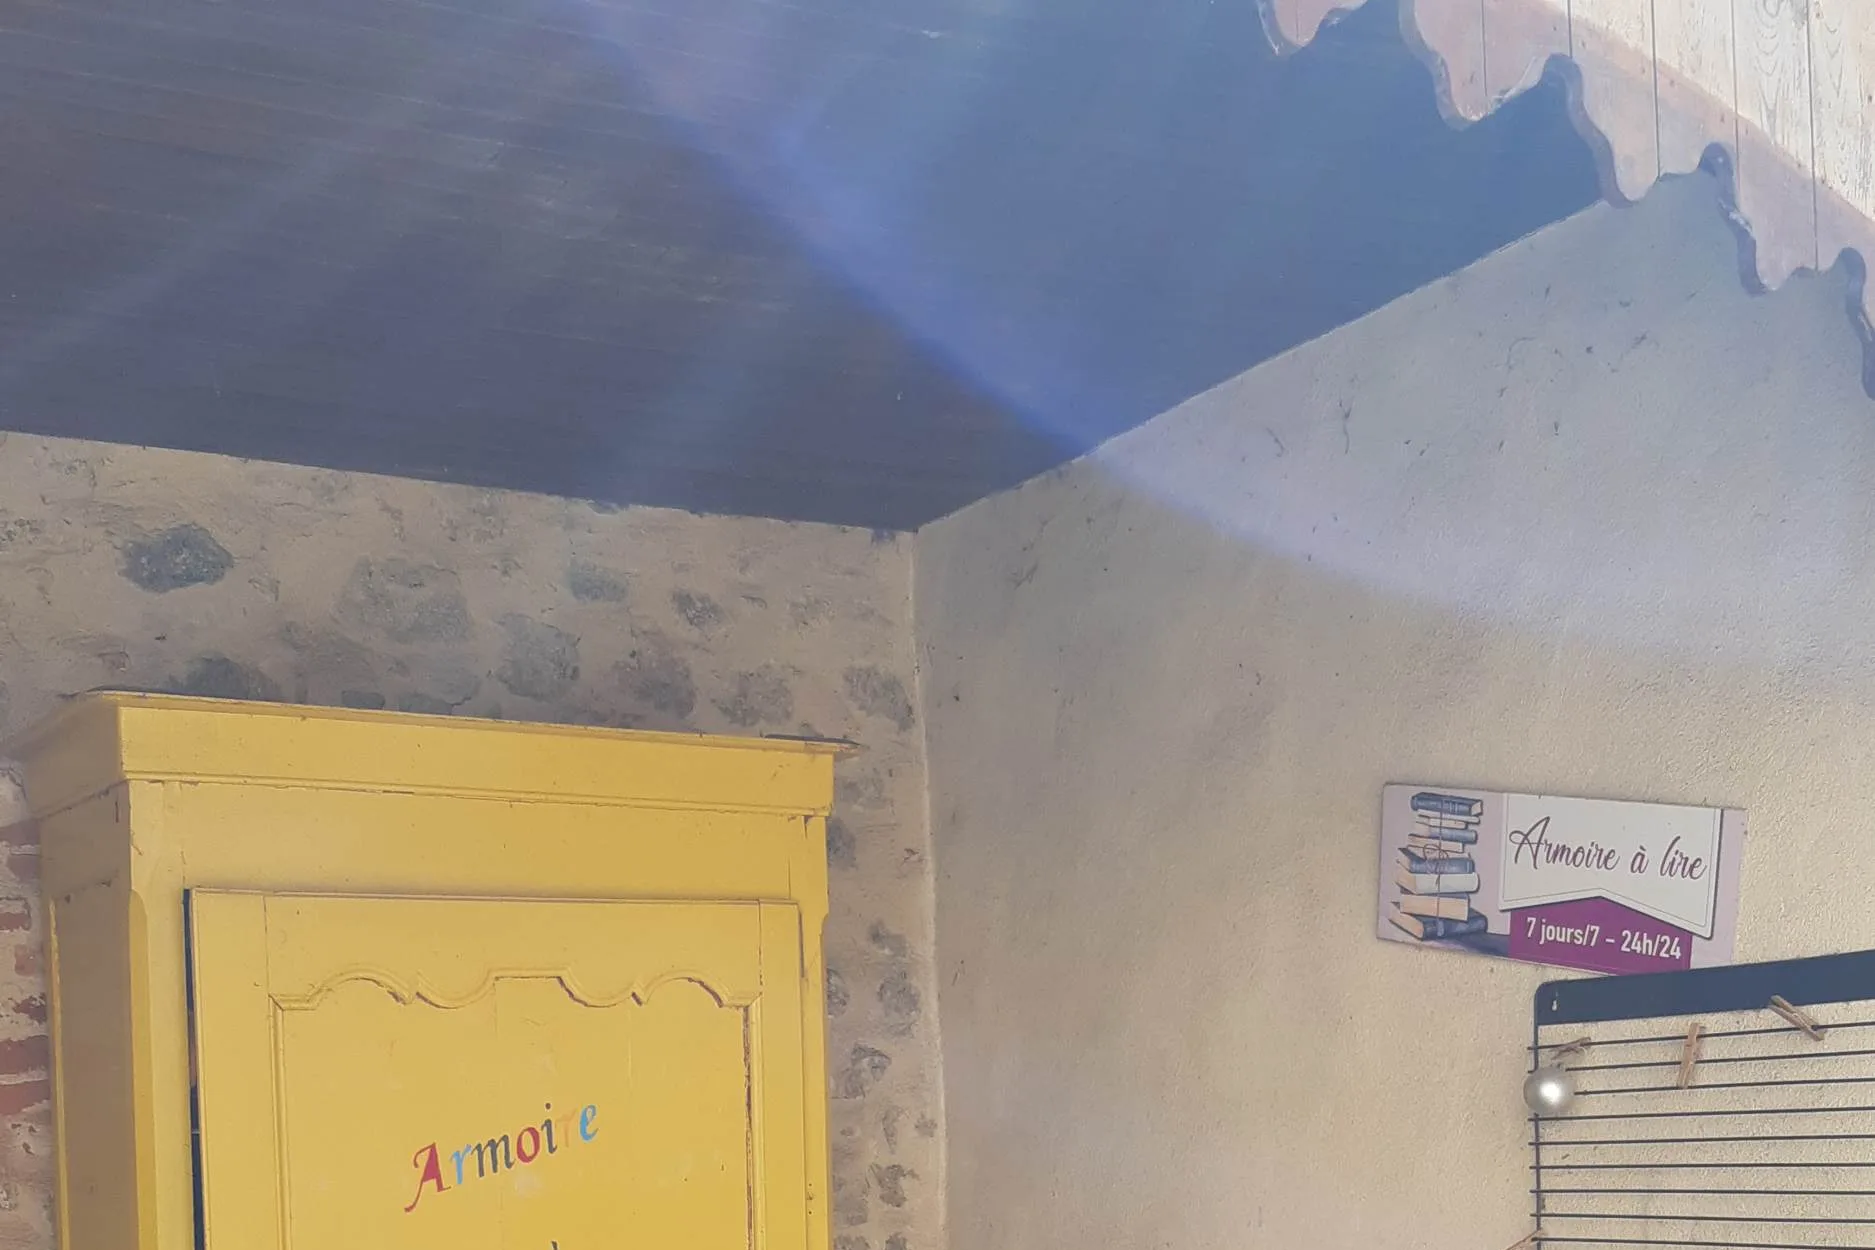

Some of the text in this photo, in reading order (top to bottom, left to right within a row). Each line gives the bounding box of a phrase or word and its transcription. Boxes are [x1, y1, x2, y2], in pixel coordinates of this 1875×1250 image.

[1509, 816, 1707, 880] Armoire à lire
[1526, 917, 1536, 938] 7
[1539, 919, 1600, 946] jours/7
[1620, 931, 1682, 960] 24h/24
[403, 1102, 599, 1212] Armoire
